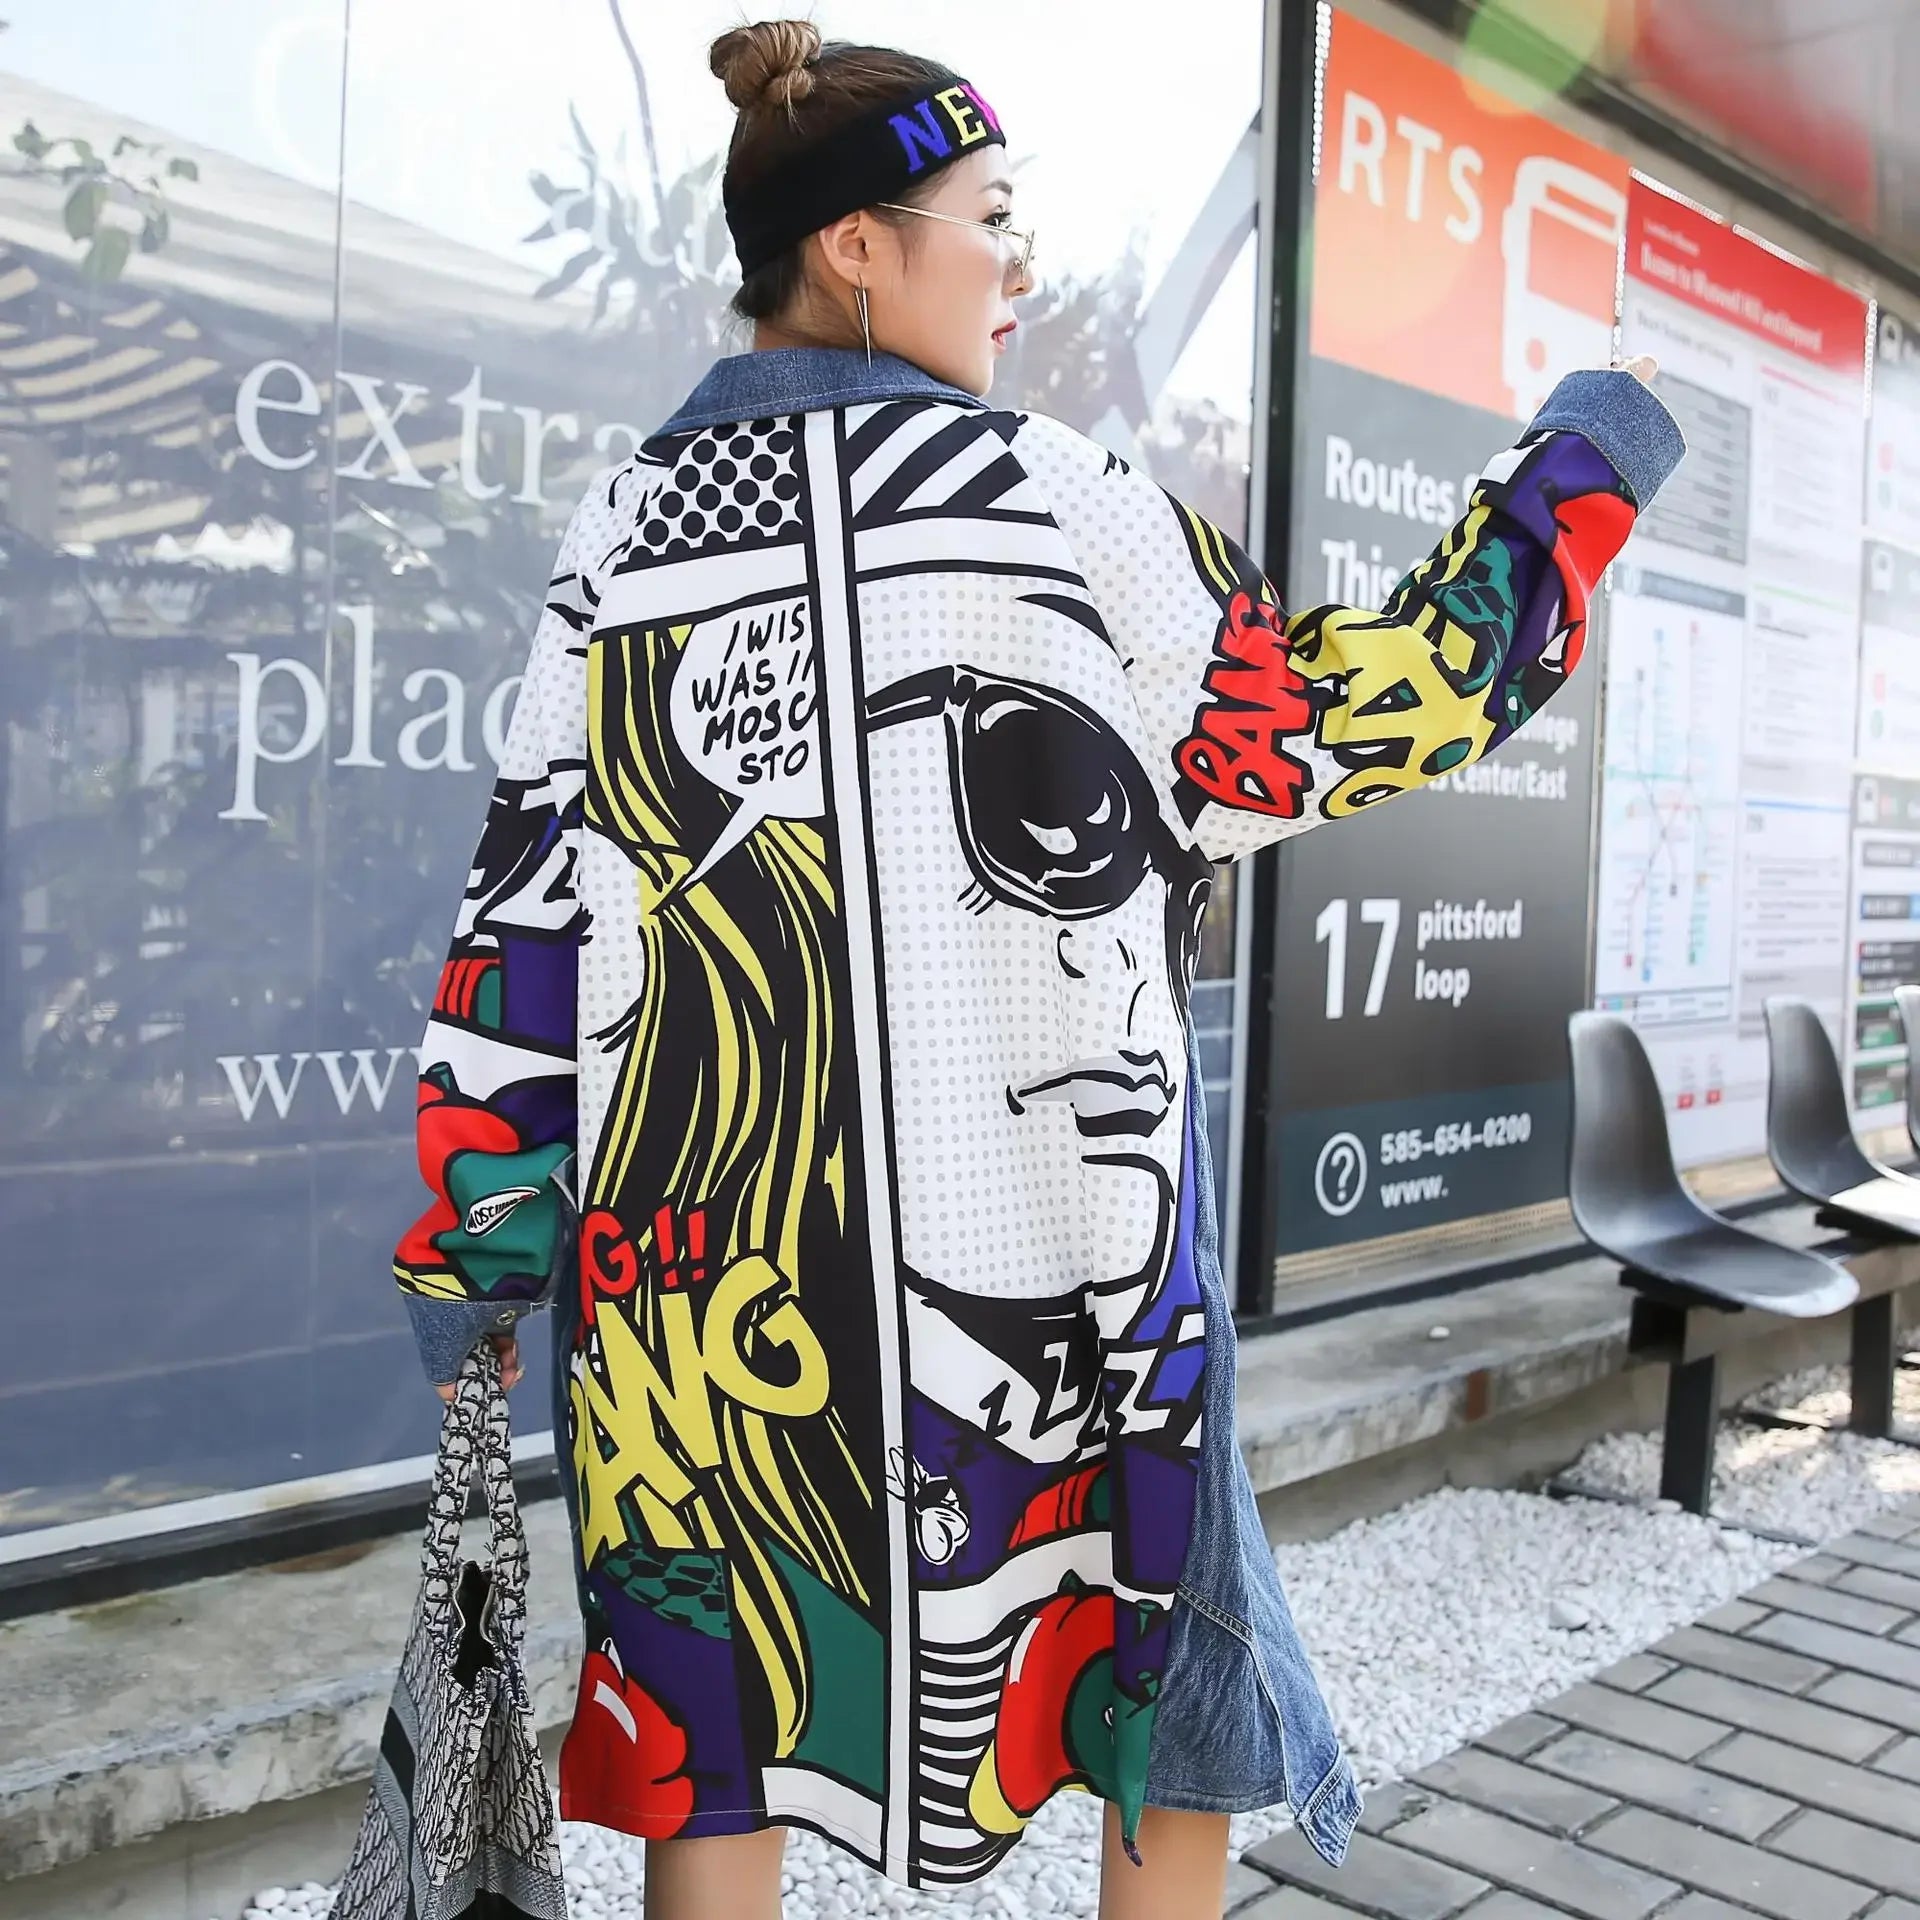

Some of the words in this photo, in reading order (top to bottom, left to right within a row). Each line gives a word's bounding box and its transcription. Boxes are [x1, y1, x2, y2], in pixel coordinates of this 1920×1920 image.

[1339, 88, 1485, 244] RTS
[1325, 434, 1455, 528] Routes
[1321, 538, 1401, 609] This
[747, 601, 807, 655] WIS
[691, 658, 776, 713] WAS
[702, 690, 818, 757] MOSC
[736, 739, 810, 785] STO
[1416, 898, 1523, 952] pittsford
[1314, 898, 1401, 1020] 17
[1414, 958, 1471, 1008] loop
[215, 1047, 422, 1122] ww
[1379, 1112, 1532, 1166] 585-654-0200
[1379, 1174, 1450, 1208] www.
